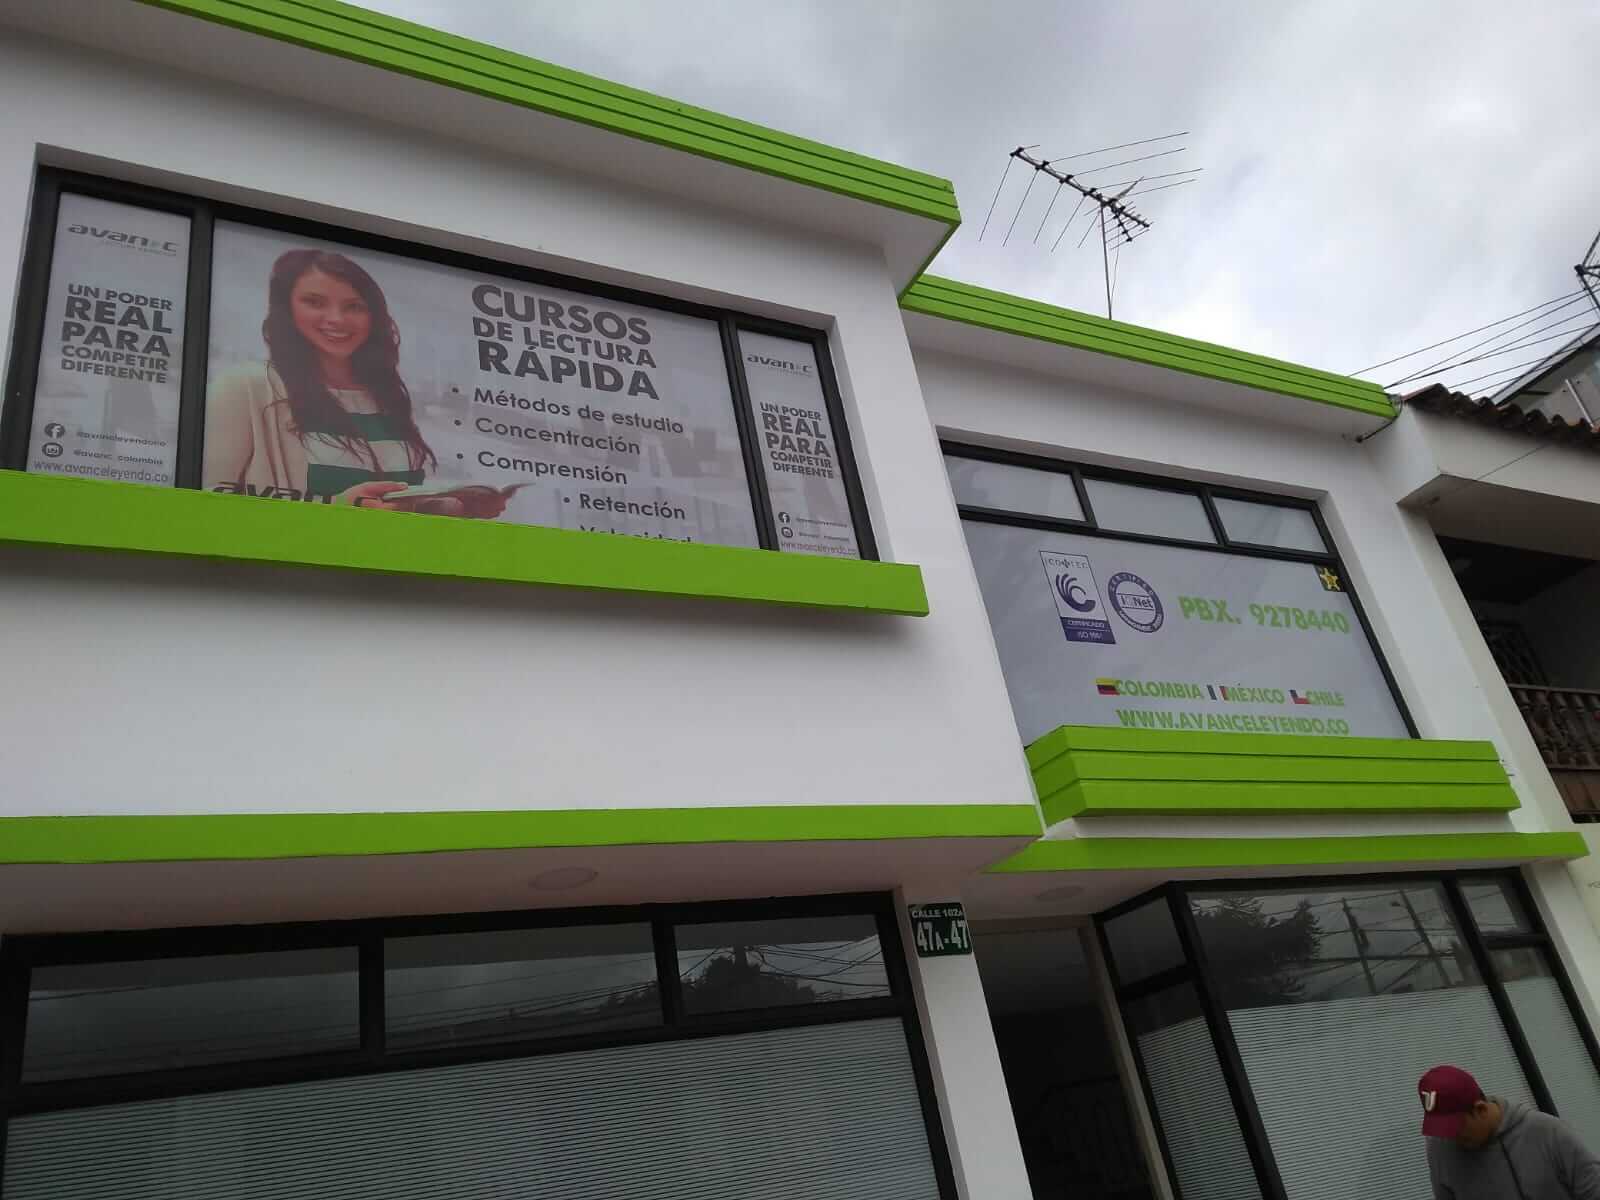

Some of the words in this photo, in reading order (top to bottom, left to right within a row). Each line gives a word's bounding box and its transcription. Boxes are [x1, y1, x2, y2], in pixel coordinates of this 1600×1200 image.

[68, 283, 100, 299] UN
[105, 289, 173, 311] PODER
[64, 295, 173, 334] REAL
[471, 284, 652, 345] CURSOS
[61, 321, 171, 358] PARA
[472, 316, 513, 342] DE
[523, 327, 657, 369] LECTURA
[61, 344, 169, 372] COMPETIR
[61, 358, 167, 384] DIFERENTE
[477, 339, 660, 401] RÁPIDA
[473, 387, 571, 417] Métodos
[577, 404, 605, 422] de
[611, 412, 685, 434] estudio
[760, 402, 779, 414] UN
[782, 405, 822, 421] PODER
[475, 416, 641, 455] Concentración
[762, 412, 827, 440] REAL
[765, 431, 832, 458] PARA
[477, 450, 628, 485] Comprensión
[770, 450, 833, 469] COMPETIR
[772, 461, 834, 480] DIFERENTE
[579, 492, 686, 520] Retención
[1178, 596, 1241, 625] PBX.
[1249, 603, 1350, 634] 9278440
[1115, 680, 1202, 700] COLOMBIA
[1115, 709, 1350, 736] WWW.AVANCELEYENDO.CO
[911, 909, 942, 919] CALLE
